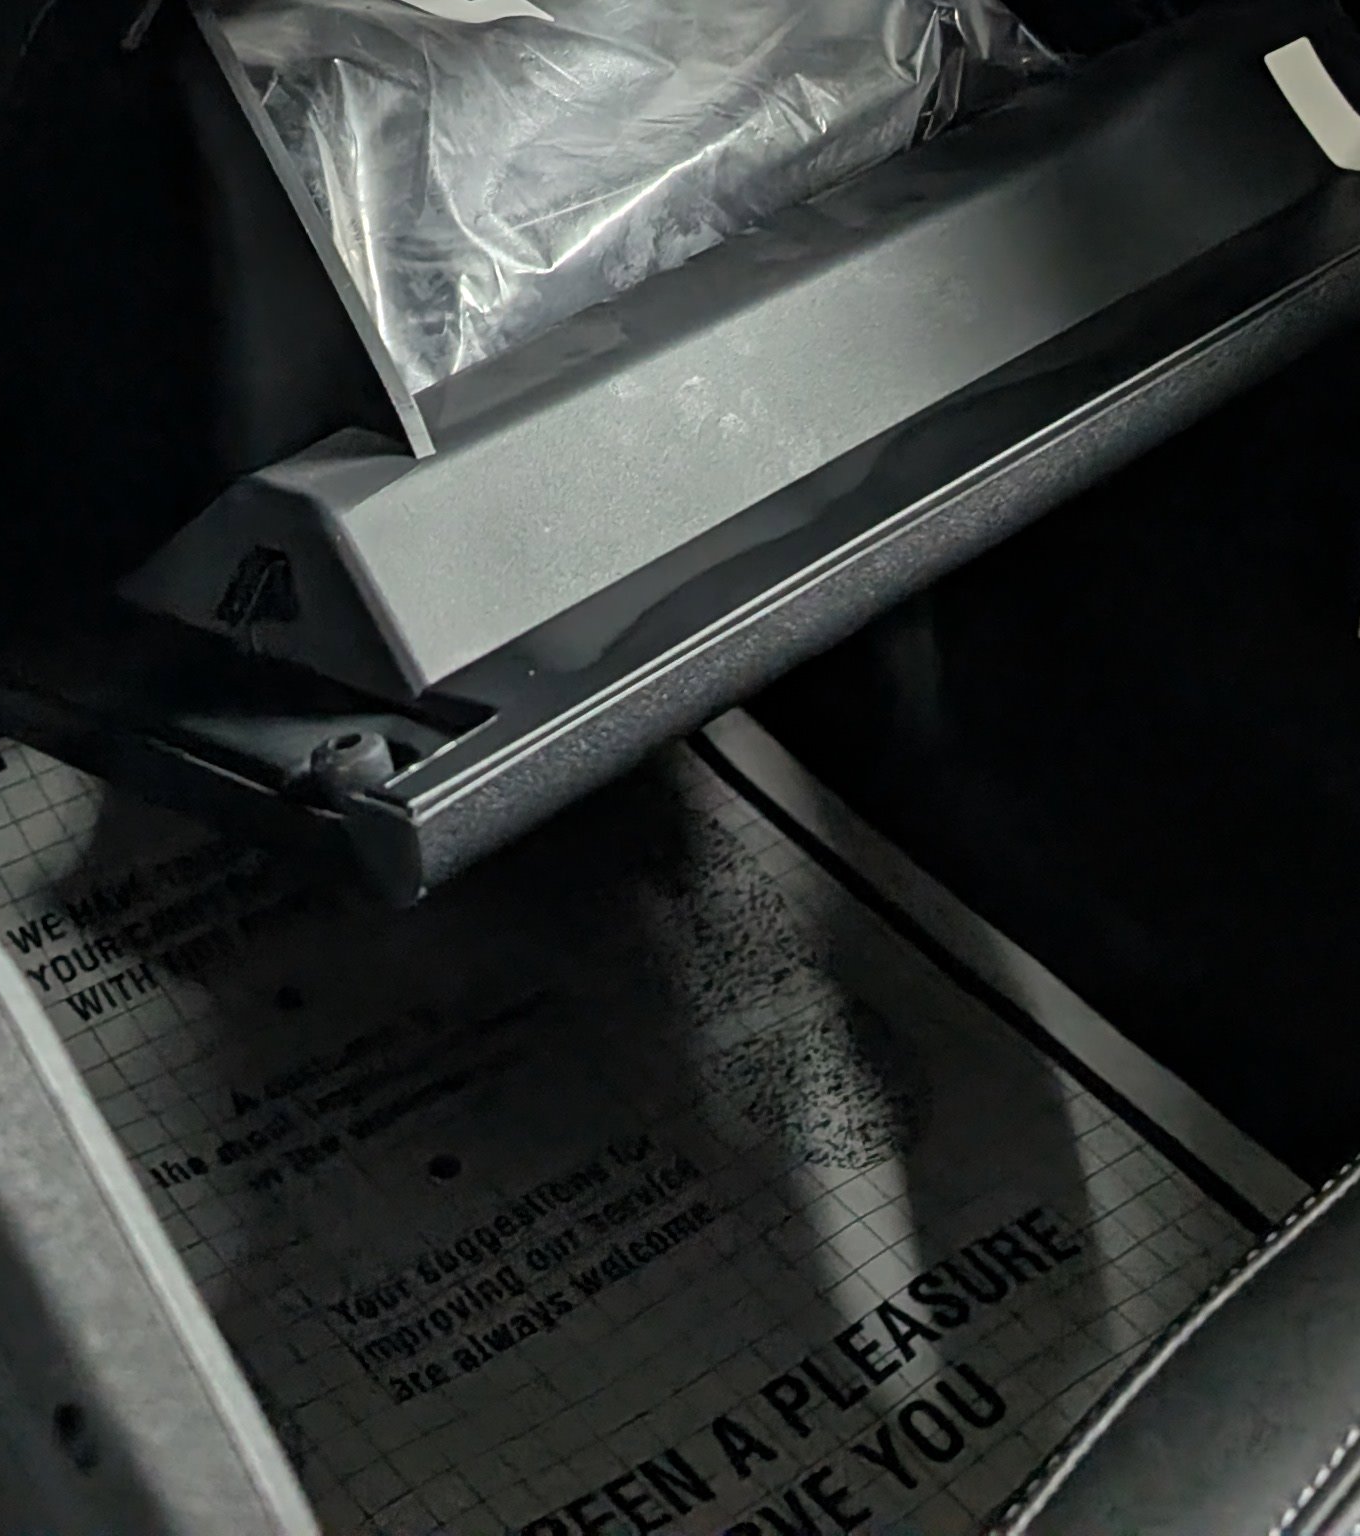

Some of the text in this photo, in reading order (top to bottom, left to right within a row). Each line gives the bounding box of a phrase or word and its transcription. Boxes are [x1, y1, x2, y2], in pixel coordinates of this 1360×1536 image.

[6, 911, 64, 956] WE
[26, 934, 124, 992] YOUR
[66, 962, 159, 1022] WITH
[328, 1276, 412, 1327] Your
[416, 1163, 611, 1286] suggestions
[525, 1227, 582, 1272] our
[386, 1199, 720, 1406] are always welcome
[710, 1415, 779, 1482] A
[758, 1206, 1086, 1441] PLEASURE
[851, 1363, 1008, 1492] YOU
